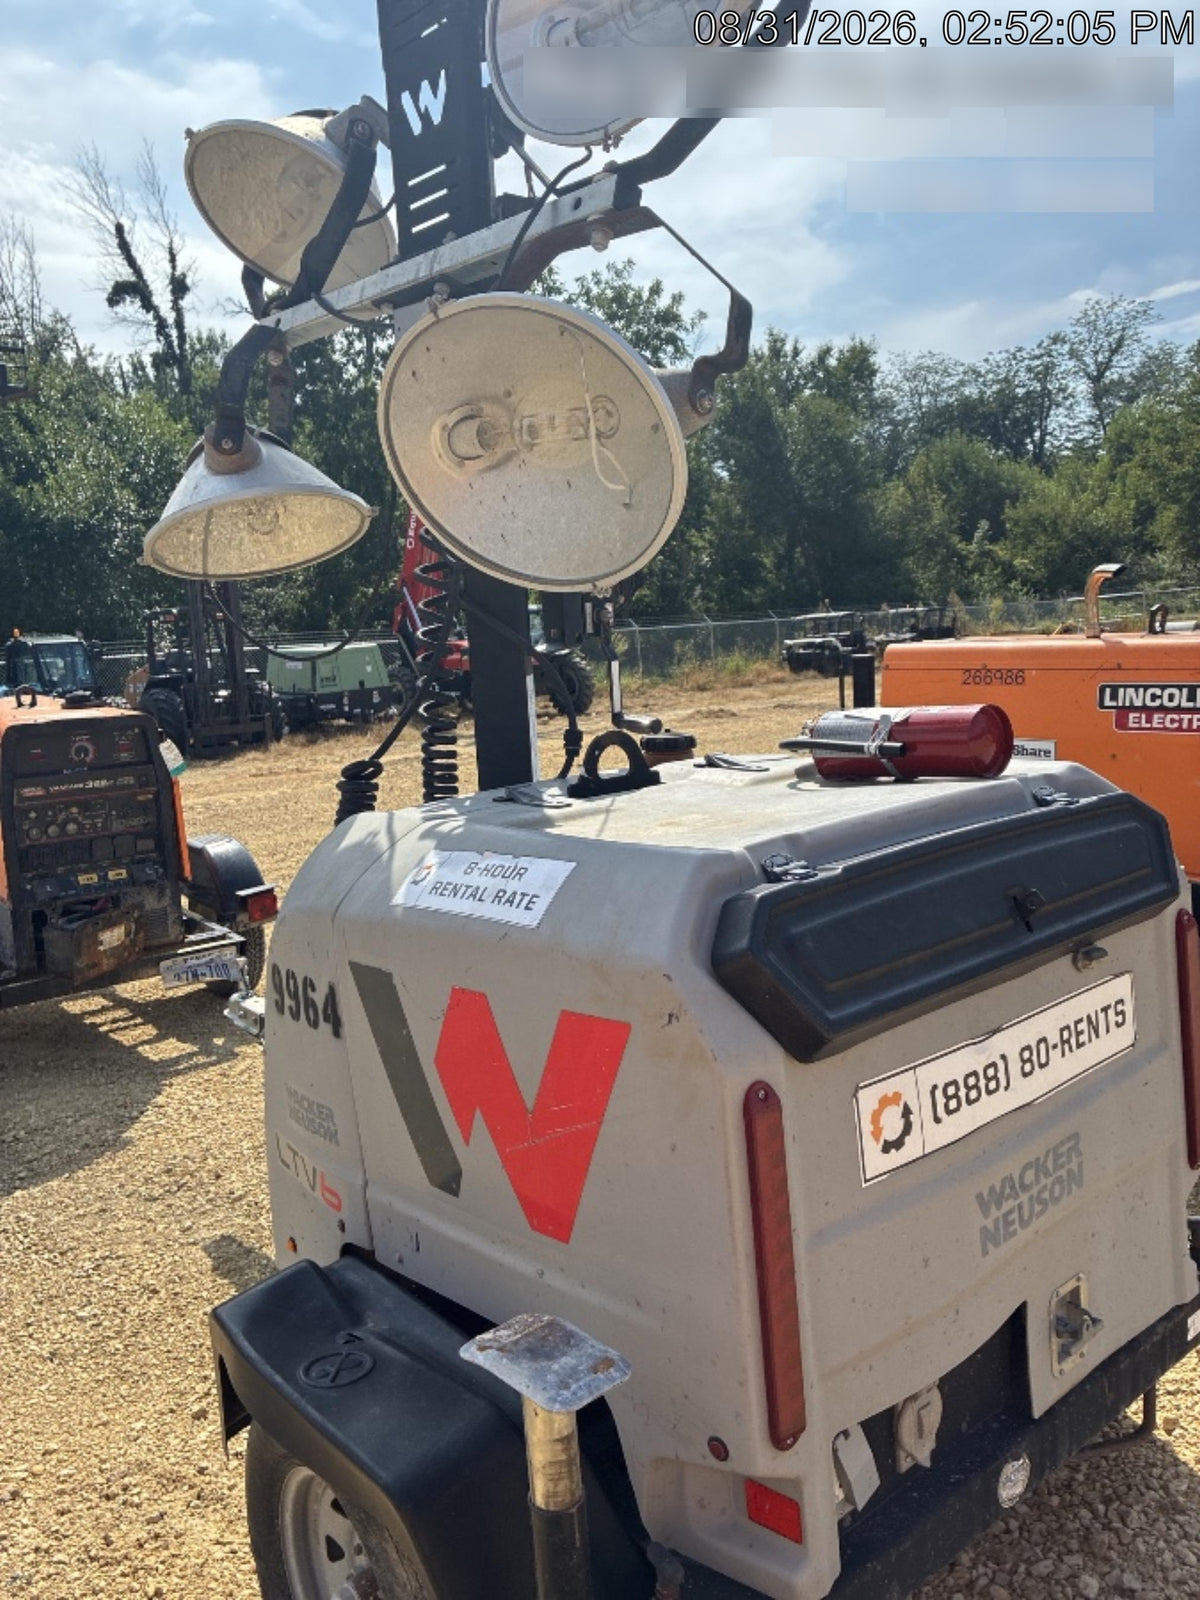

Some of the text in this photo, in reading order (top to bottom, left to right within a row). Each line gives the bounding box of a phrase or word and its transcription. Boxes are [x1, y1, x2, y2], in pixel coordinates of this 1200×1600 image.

[962, 669, 1025, 686] 266986
[1103, 687, 1200, 708] LINCOL
[428, 881, 541, 911] RENTAL RATE
[271, 962, 342, 1039] 9964
[929, 997, 1127, 1125] (888) 80-RENTS
[974, 1131, 1083, 1220] WACKER
[978, 1160, 1084, 1258] NEUSON
